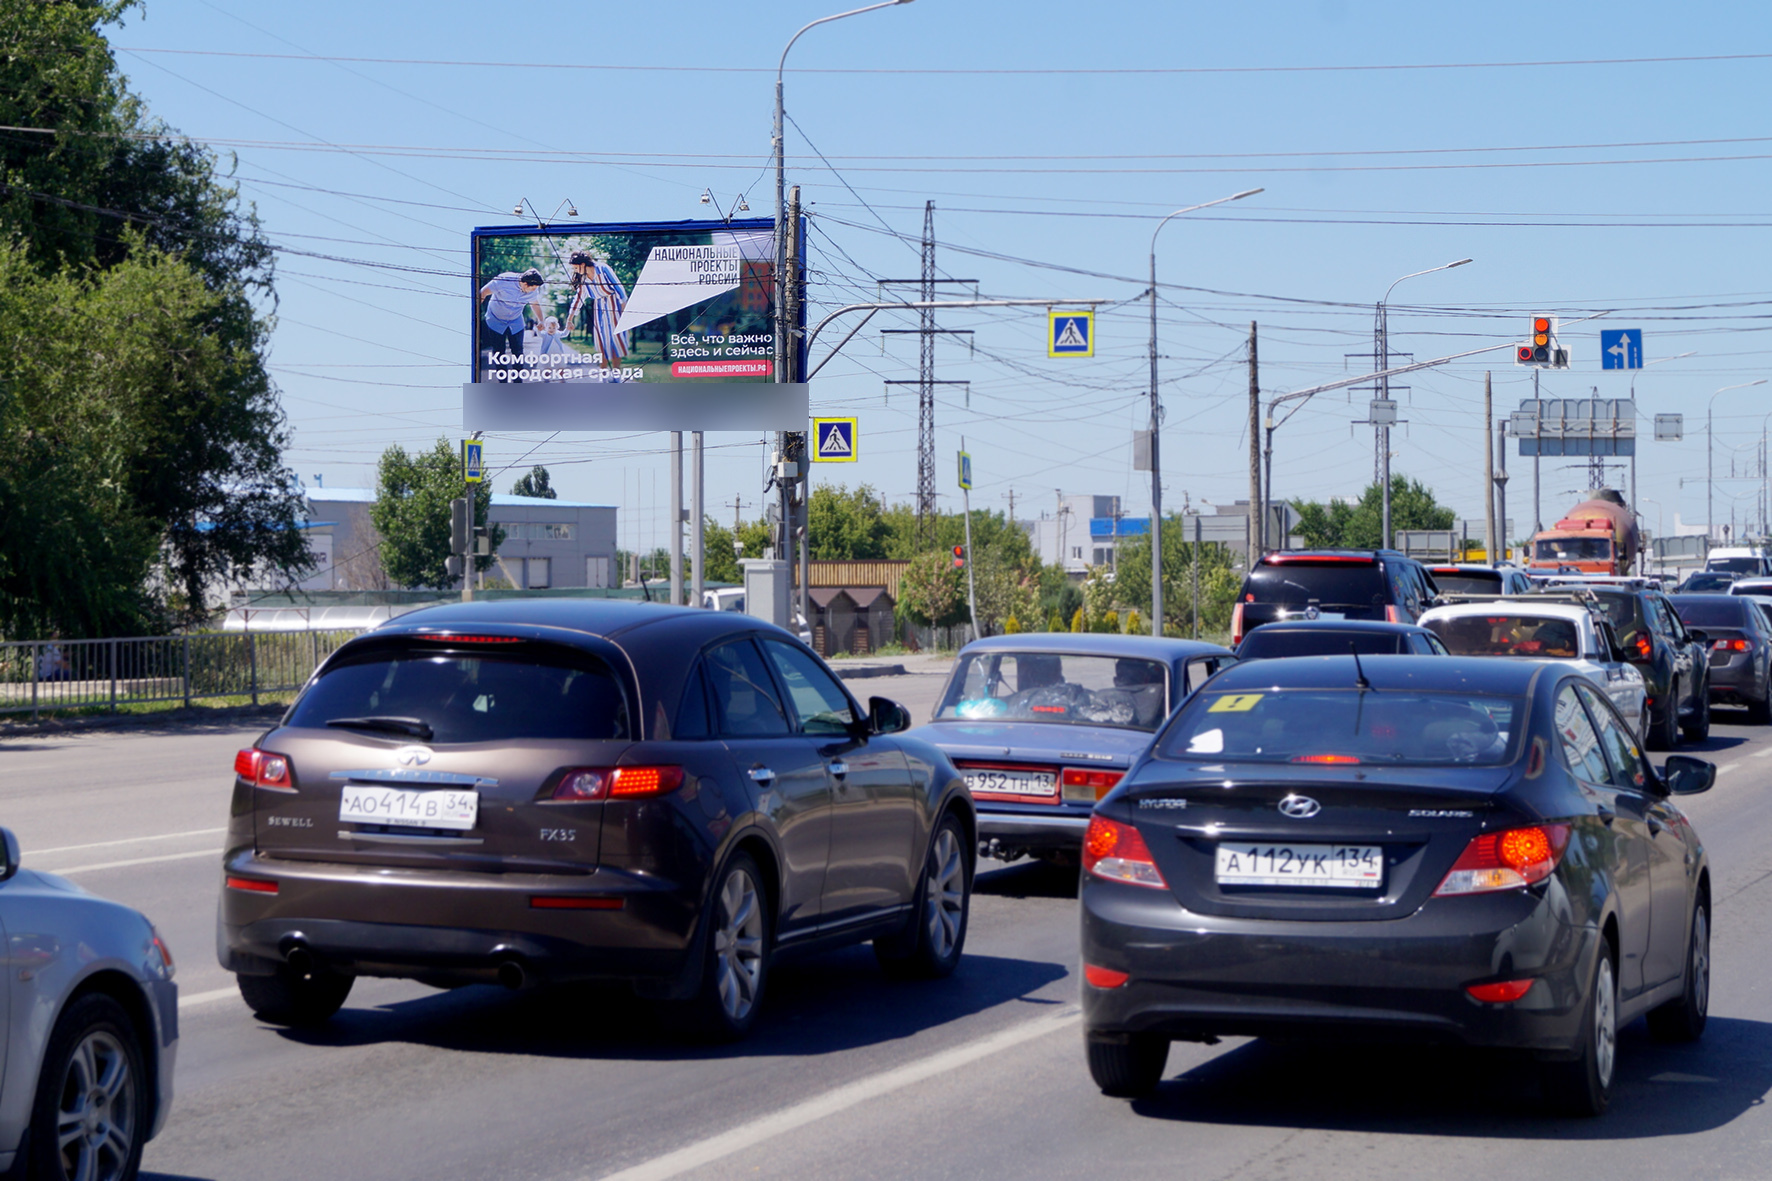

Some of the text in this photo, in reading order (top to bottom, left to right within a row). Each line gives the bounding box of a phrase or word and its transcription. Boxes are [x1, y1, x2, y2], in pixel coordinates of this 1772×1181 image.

[654, 247, 738, 261] НАЦИОНАЛЬНЫЕ
[690, 260, 738, 273] ПРОЕКТЫ
[699, 273, 738, 285] РОССИИ
[671, 334, 773, 346] Всё, что важно
[670, 344, 774, 358] здесь и сейчас
[488, 351, 603, 368] Комфортная
[488, 367, 644, 383] городская среда
[677, 363, 767, 374] НАЦИОНАЛЬНЫЕПРОЕКТЫ.РФ
[1408, 809, 1474, 818] SOLARIS
[268, 816, 314, 828] SEWELL
[540, 828, 577, 842] FX35
